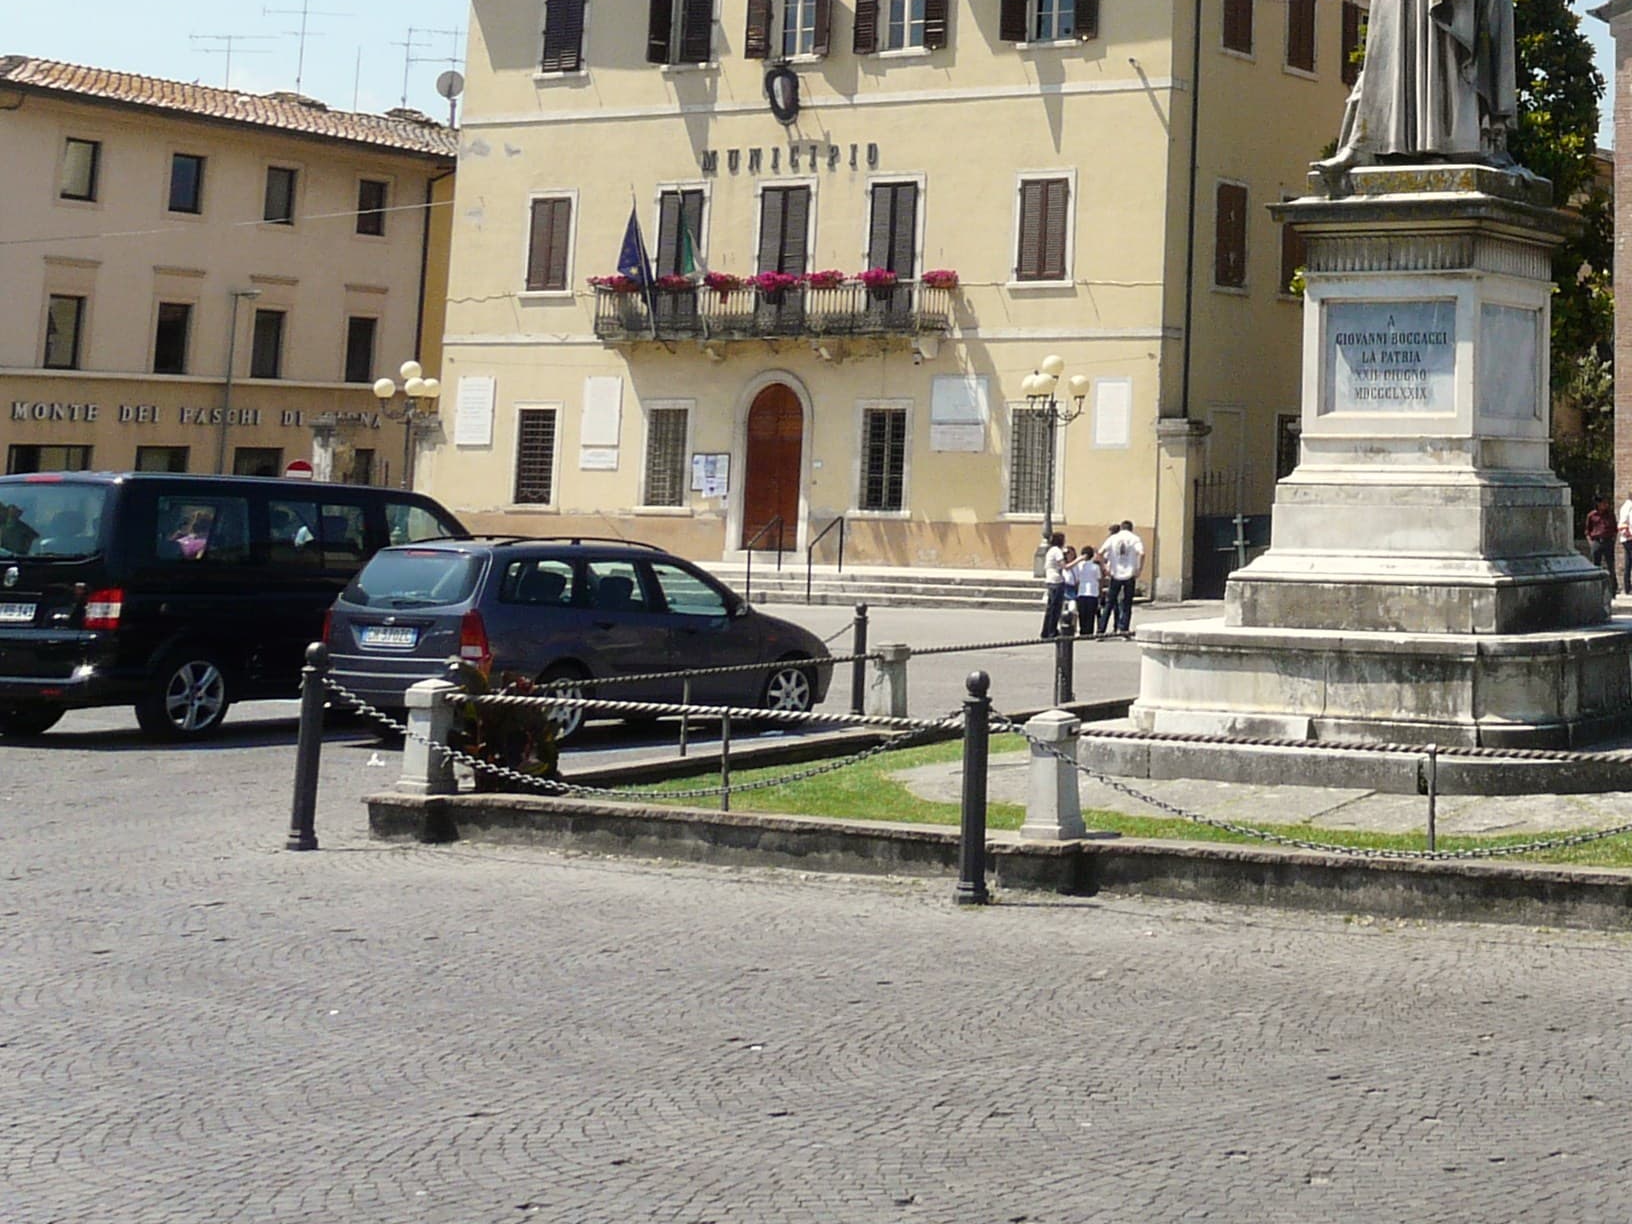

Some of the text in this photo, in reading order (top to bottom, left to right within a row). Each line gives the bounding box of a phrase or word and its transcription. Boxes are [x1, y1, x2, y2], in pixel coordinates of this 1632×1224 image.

[701, 142, 879, 172] MUNICIPIO
[1387, 314, 1396, 327] A
[1335, 332, 1388, 345] GIOVANNI
[1361, 351, 1421, 364] LA PATRIA
[1383, 368, 1427, 382] GIUGNO
[1355, 387, 1427, 400] MDCCCLXXIX
[11, 401, 99, 423] MONTE
[119, 404, 161, 424] DEI
[180, 407, 262, 426] PASCHI
[281, 409, 305, 427] DI
